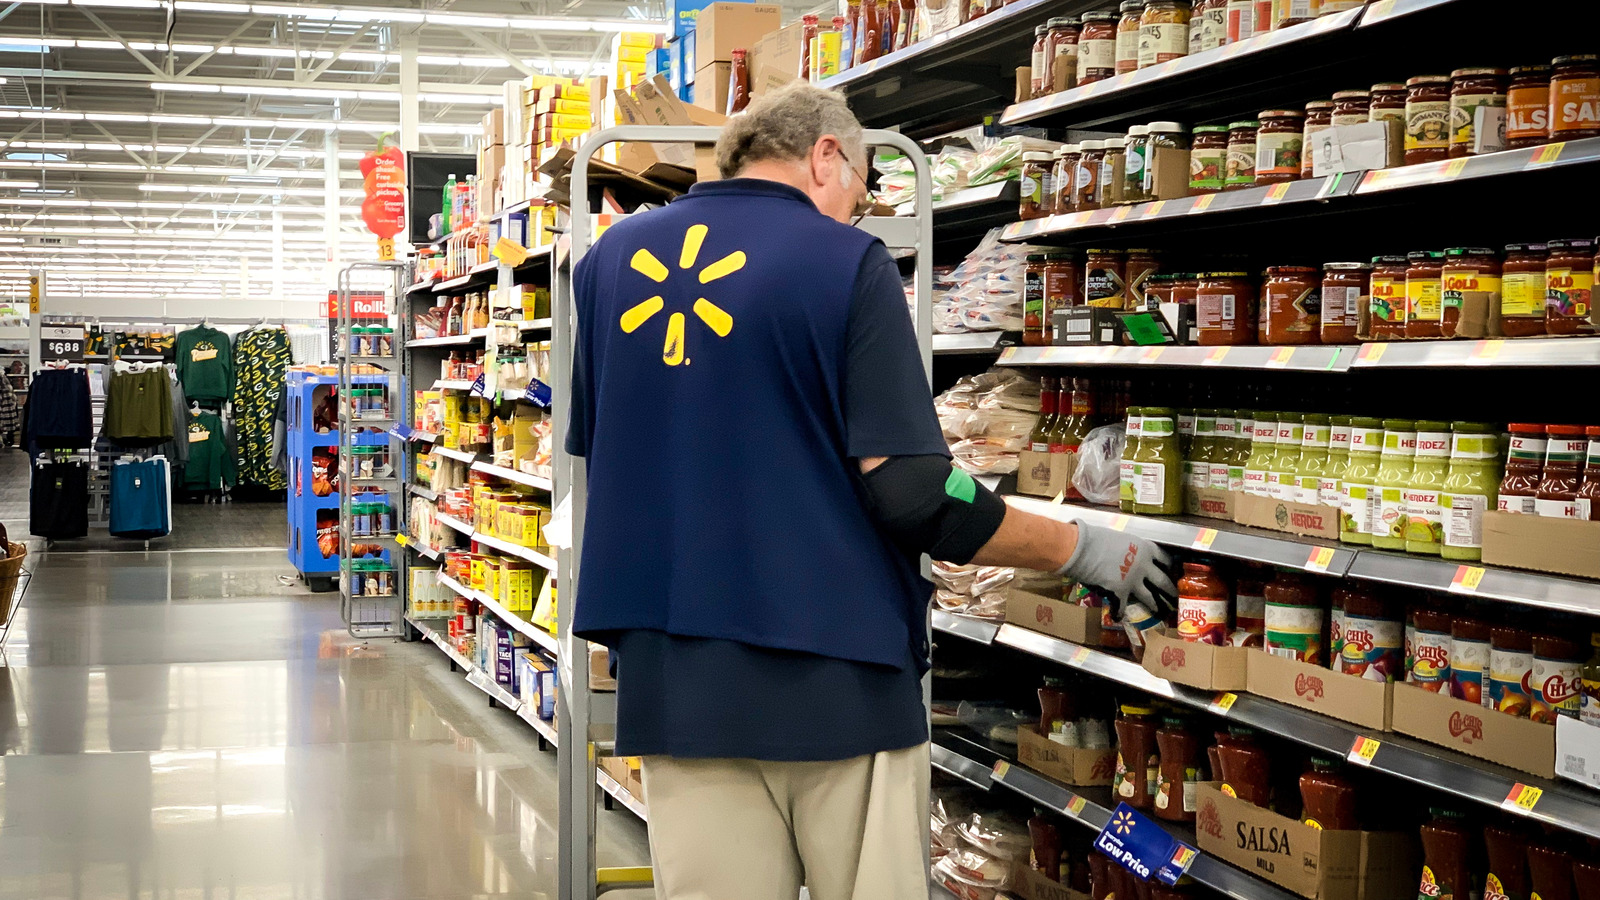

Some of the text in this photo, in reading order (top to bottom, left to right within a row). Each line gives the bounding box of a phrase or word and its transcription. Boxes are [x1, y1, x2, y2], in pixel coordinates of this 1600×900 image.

[1506, 110, 1547, 130] ALS
[381, 245, 392, 257] 13
[1447, 277, 1478, 290] GOLD
[1291, 512, 1324, 530] HERDEZ
[1119, 542, 1138, 581] ACE
[1105, 831, 1124, 847] Everyday
[1236, 821, 1291, 856] SALSA
[1099, 835, 1123, 858] Low
[1122, 851, 1149, 878] Price
[1256, 857, 1274, 874] MILD
